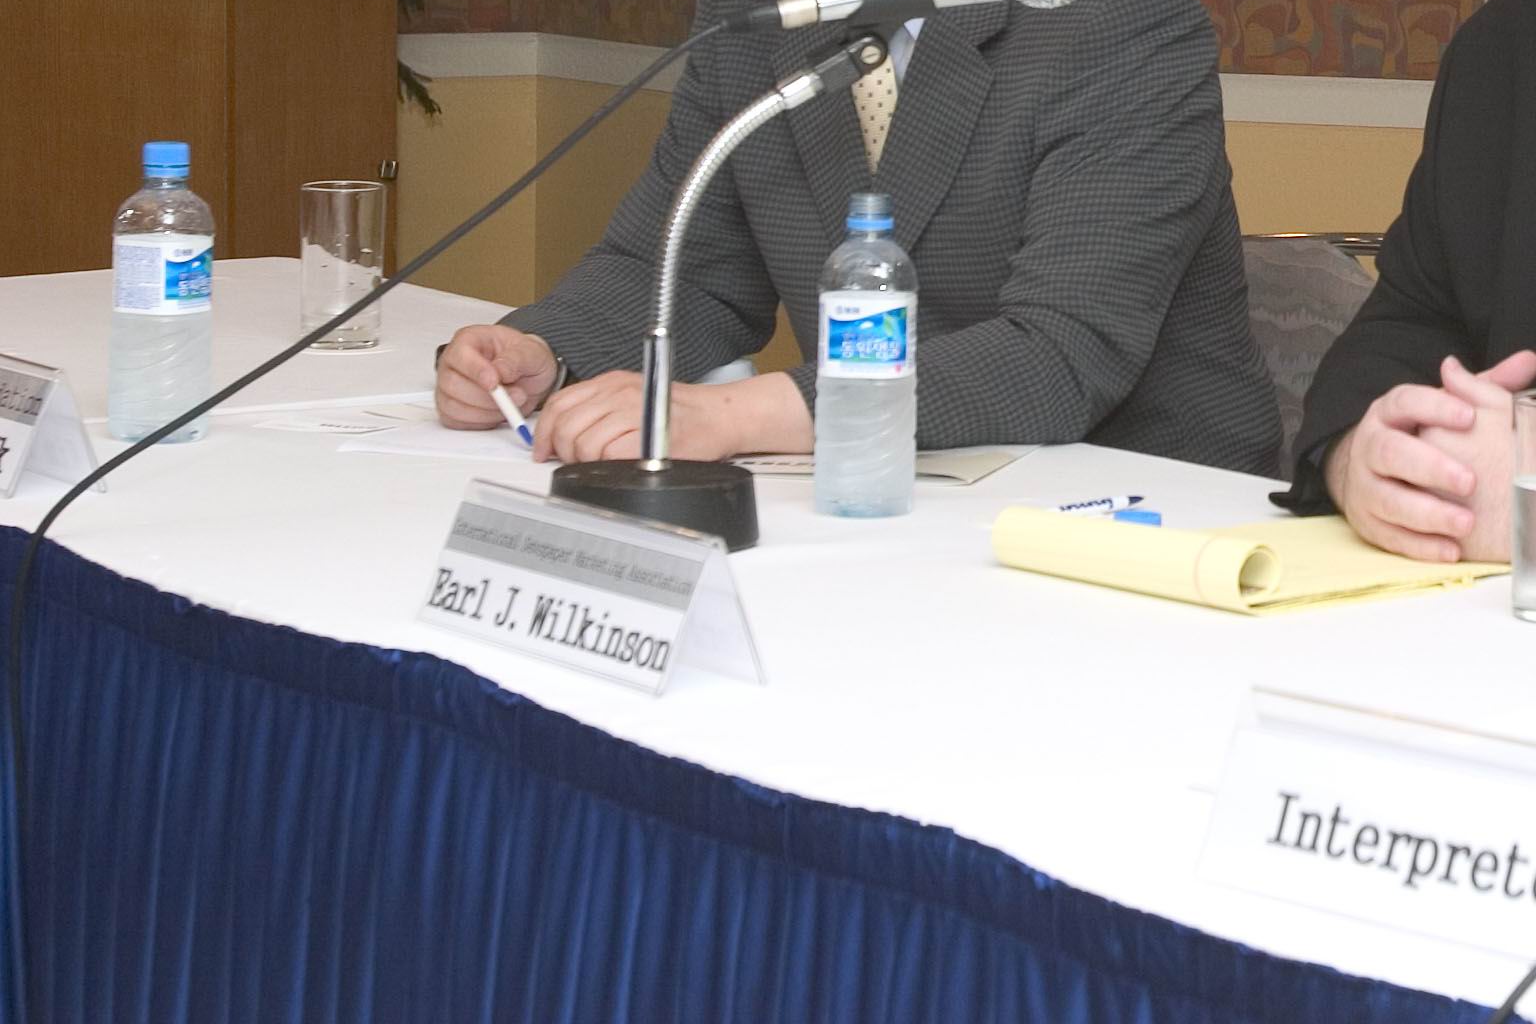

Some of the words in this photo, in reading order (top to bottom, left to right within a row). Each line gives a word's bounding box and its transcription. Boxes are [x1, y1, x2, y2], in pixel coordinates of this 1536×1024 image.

[428, 567, 489, 620] Earl
[495, 586, 519, 631] J.
[527, 595, 671, 673] Wilkinson
